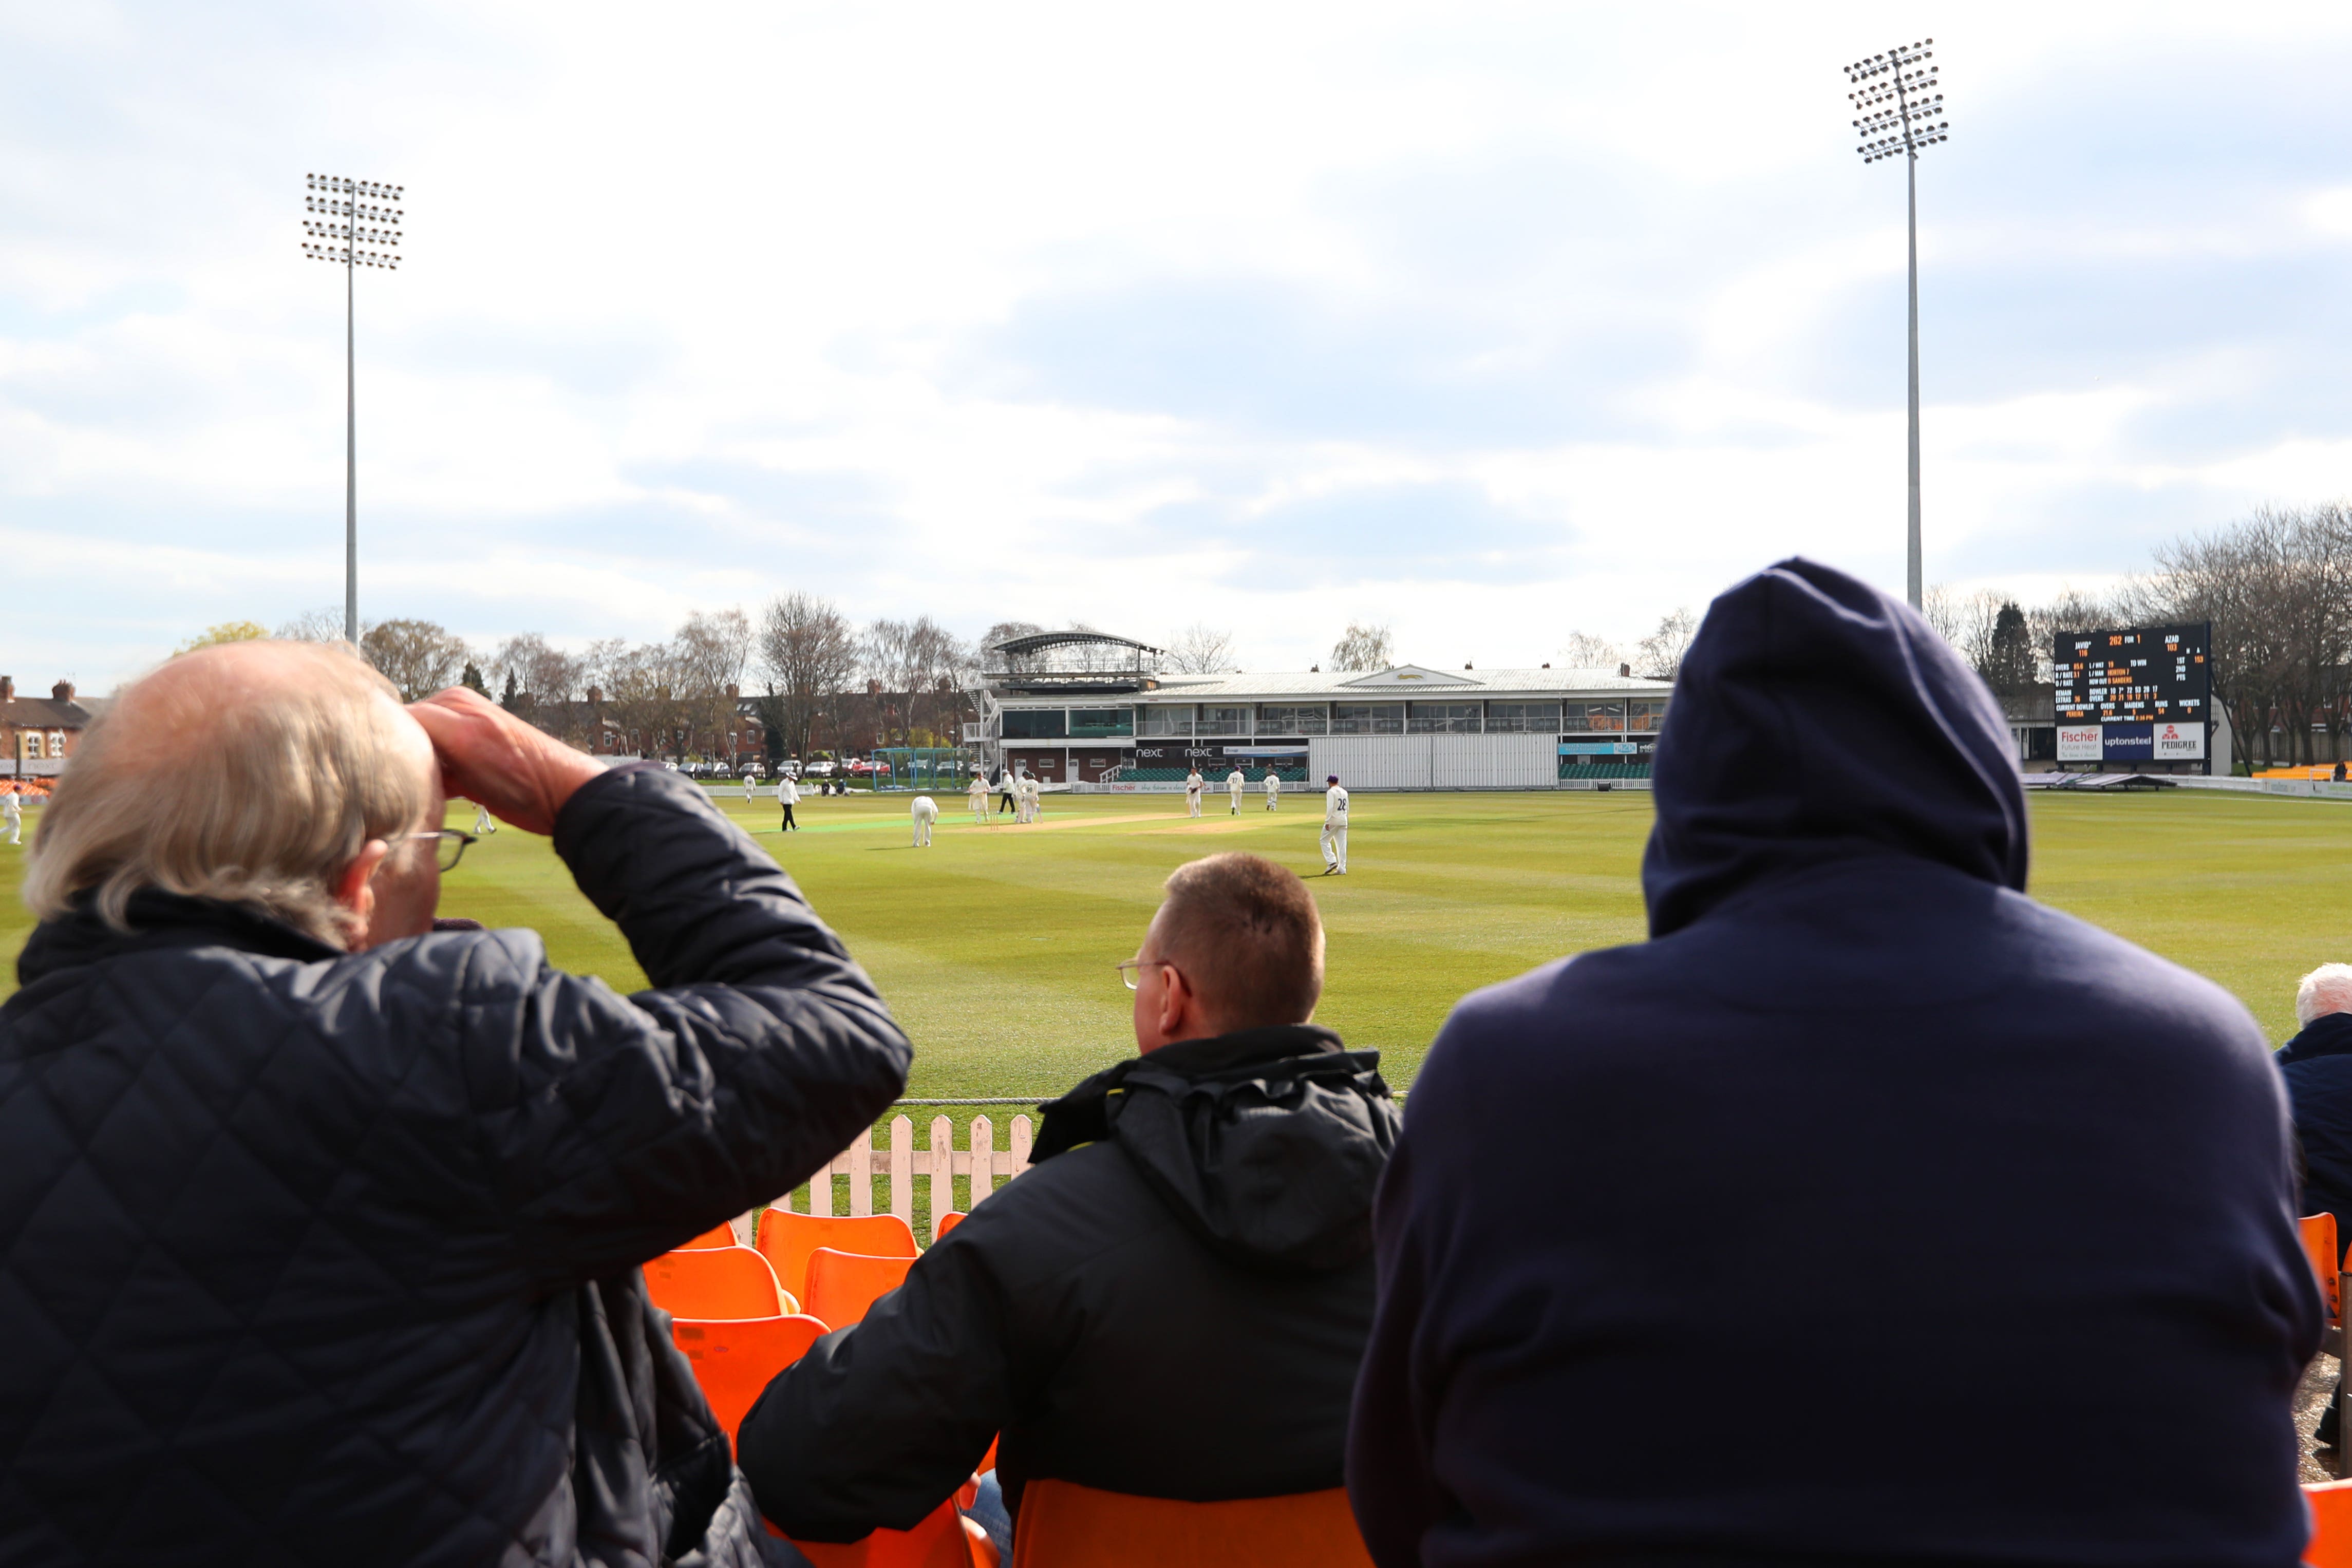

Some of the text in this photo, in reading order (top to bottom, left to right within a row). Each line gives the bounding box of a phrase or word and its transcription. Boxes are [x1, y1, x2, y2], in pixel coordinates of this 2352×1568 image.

[2137, 634, 2140, 644] 1
[2165, 635, 2179, 644] AZAD
[2062, 731, 2098, 742] Fischer
[2105, 736, 2151, 747] uptonsteel
[2161, 741, 2196, 749] PEDIGREE
[1136, 748, 1212, 757] next next
[1338, 798, 1347, 811] 28
